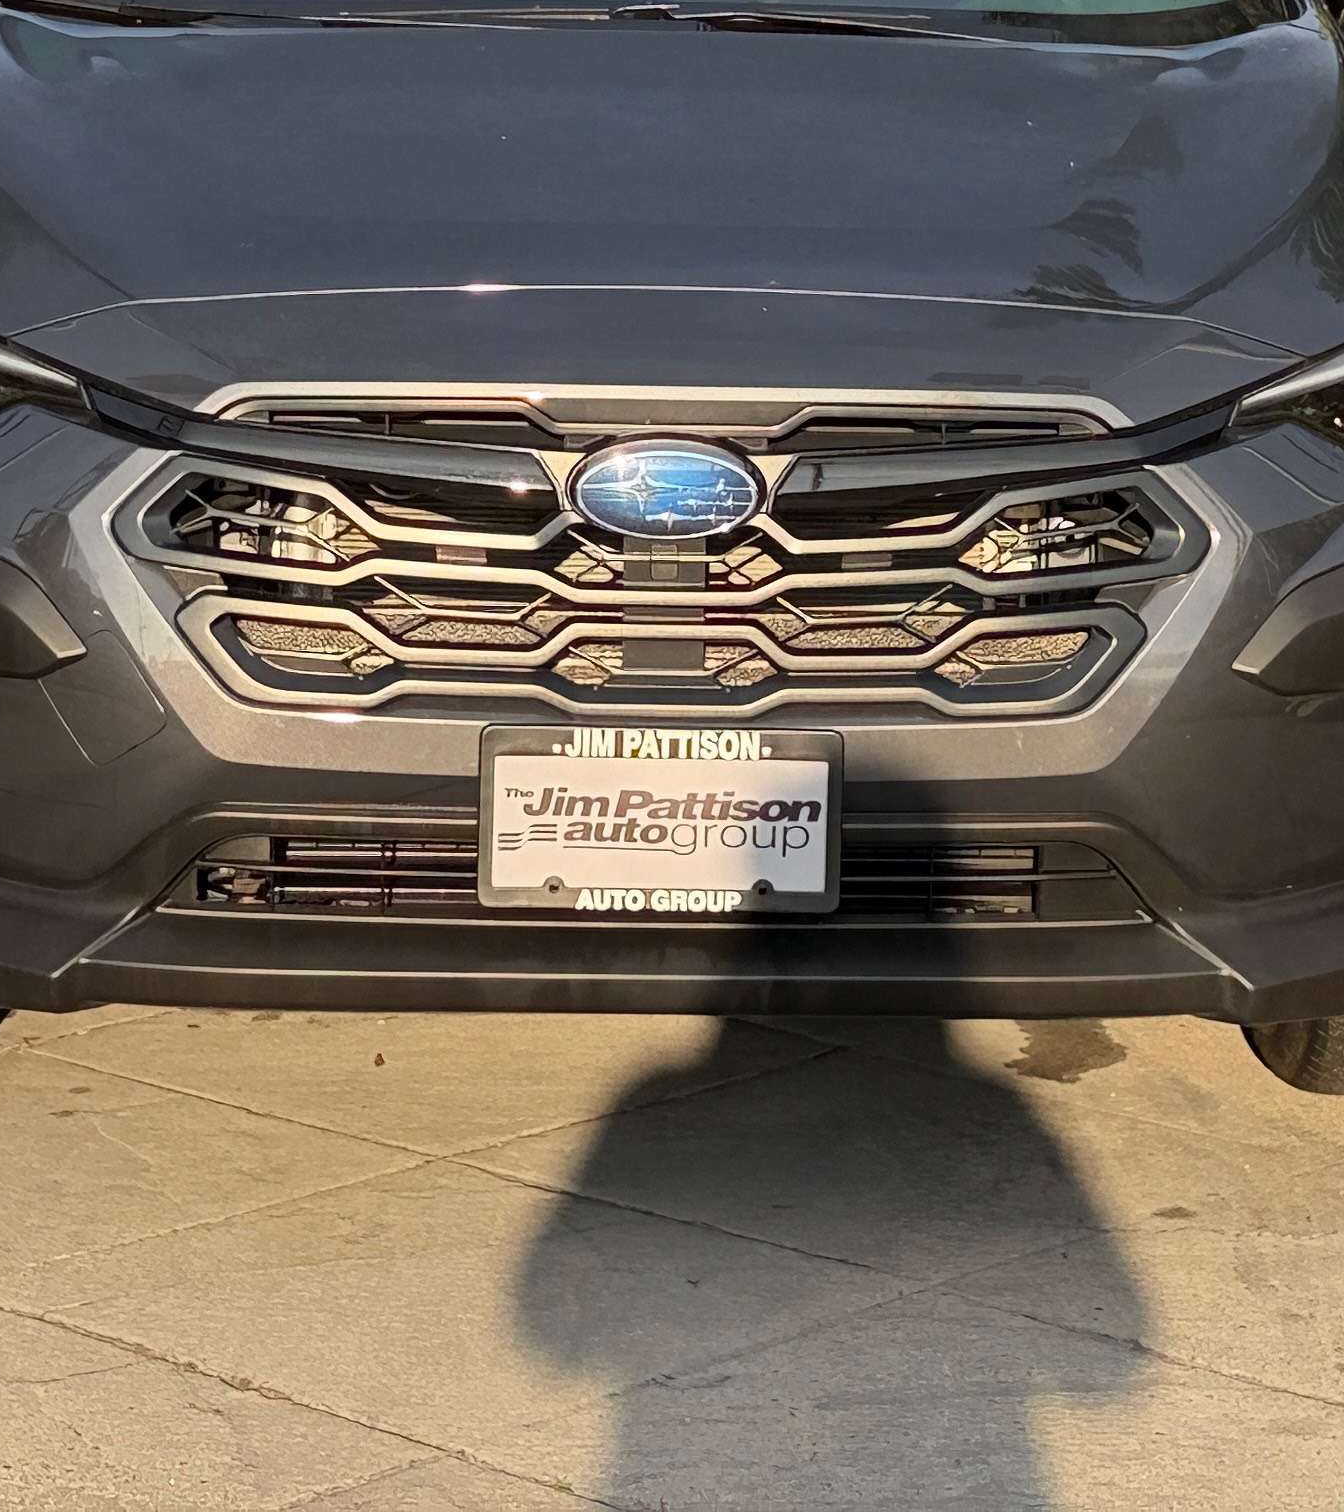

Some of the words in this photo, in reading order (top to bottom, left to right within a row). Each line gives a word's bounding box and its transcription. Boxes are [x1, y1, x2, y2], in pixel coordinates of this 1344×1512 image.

[564, 728, 616, 759] JIM
[628, 728, 761, 761] PATTISON
[505, 787, 535, 799] The
[614, 789, 822, 822] Pattison
[575, 889, 647, 912] AUTO
[651, 890, 742, 913] GROUP
